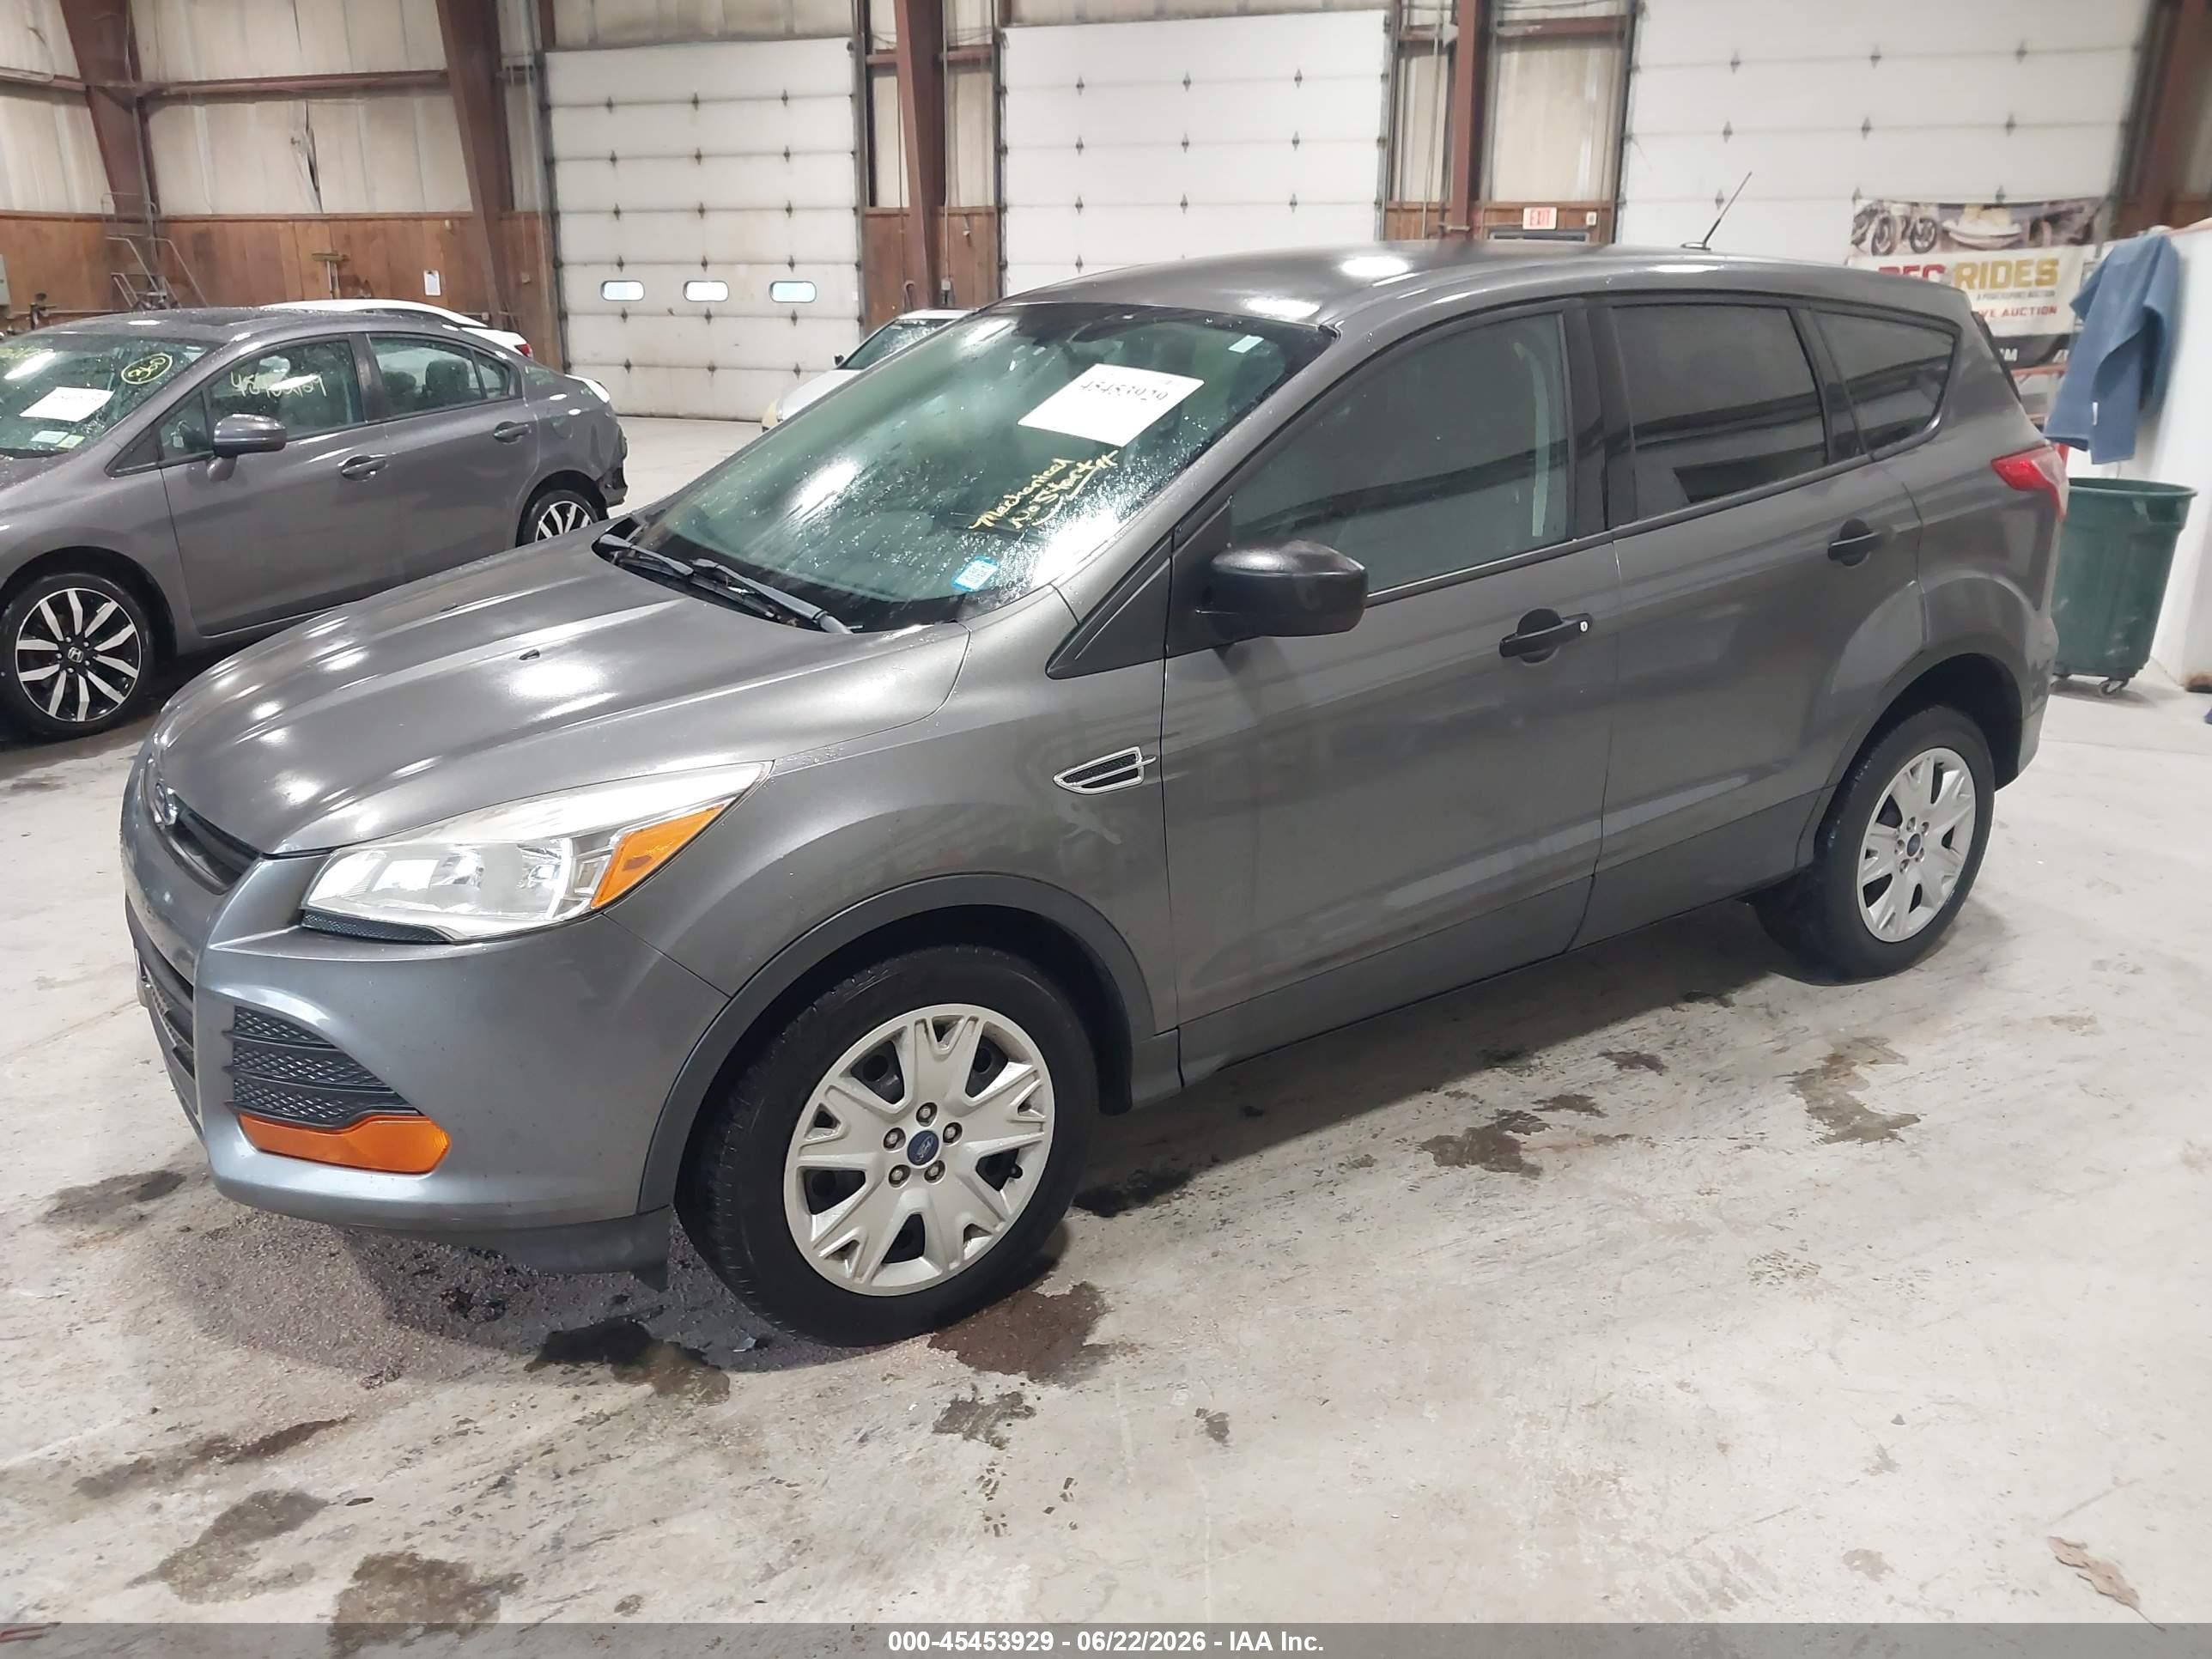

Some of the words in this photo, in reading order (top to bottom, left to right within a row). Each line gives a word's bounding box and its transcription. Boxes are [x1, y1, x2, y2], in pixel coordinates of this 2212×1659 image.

[1530, 208, 1551, 228] EXIT
[1954, 259, 2059, 289] RIDES
[2002, 305, 2058, 317] AUCTION
